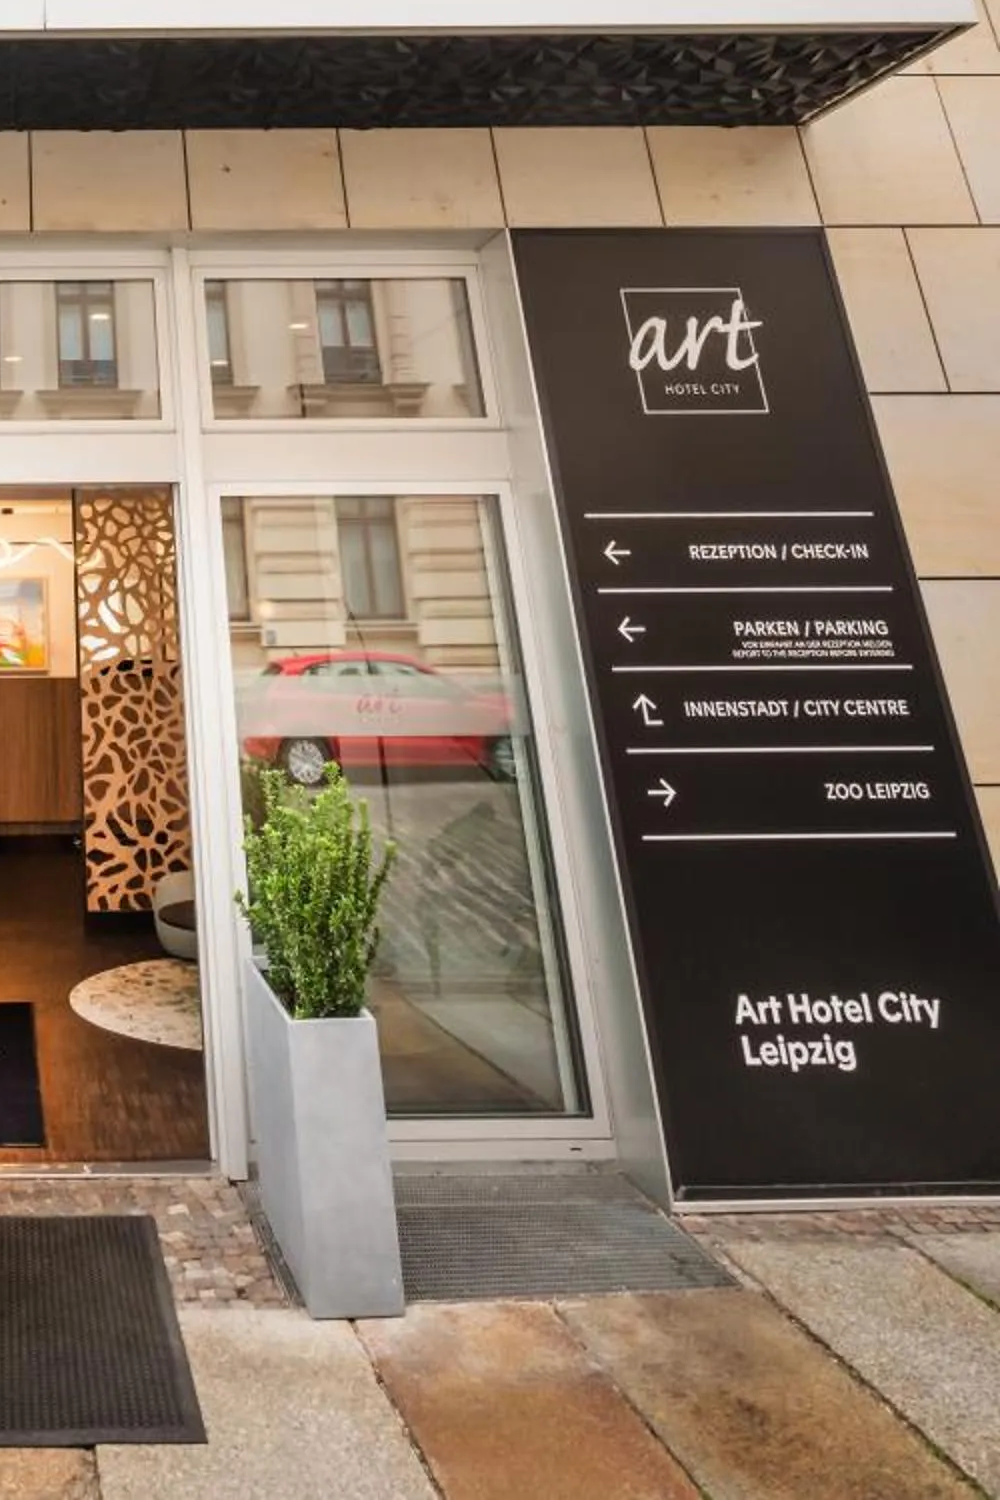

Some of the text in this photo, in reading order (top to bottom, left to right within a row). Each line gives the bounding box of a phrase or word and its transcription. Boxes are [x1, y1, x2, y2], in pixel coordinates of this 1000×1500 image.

[629, 299, 763, 371] art
[664, 383, 739, 395] HOTEL CITY
[688, 544, 778, 560] REZEPTION
[790, 543, 869, 559] CHECK-IN
[733, 620, 801, 637] PARKEN
[813, 619, 889, 636] PARKING
[683, 700, 789, 717] INNENSTADT
[803, 699, 840, 717] CITY
[843, 699, 910, 716] CENTRE
[824, 782, 931, 800] ZOO LEIPZIG
[735, 991, 940, 1029] Art Hotel City
[740, 1033, 857, 1073] Leipzig
